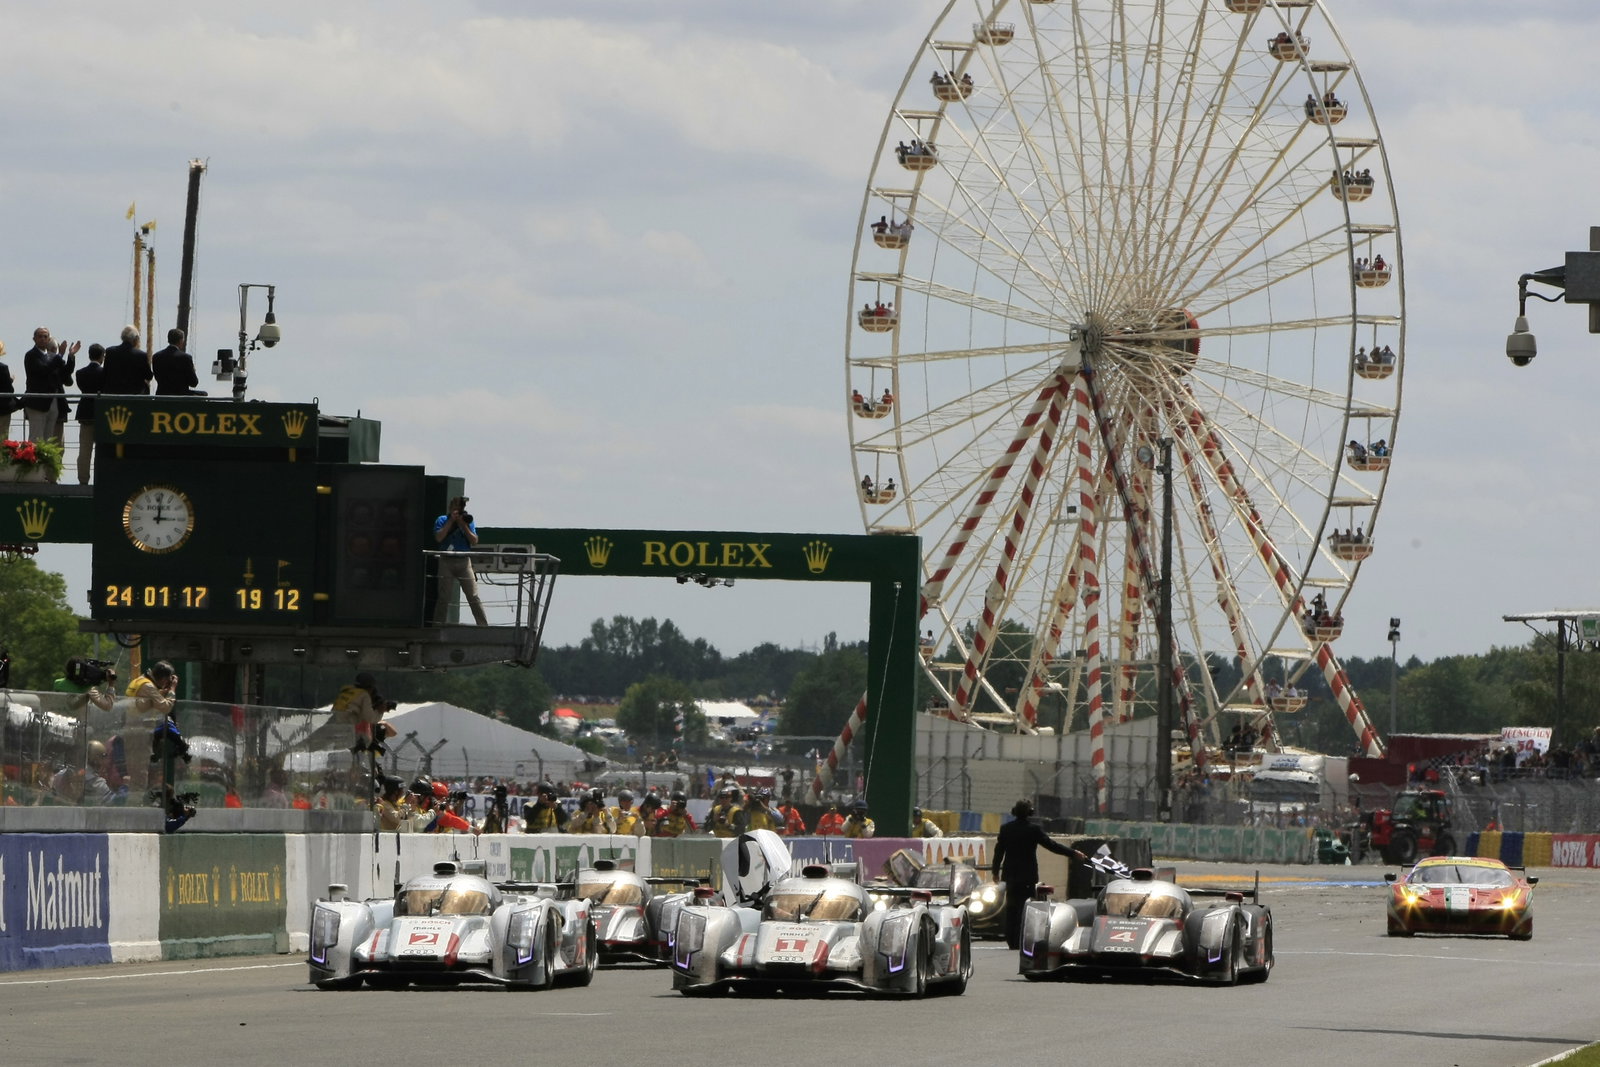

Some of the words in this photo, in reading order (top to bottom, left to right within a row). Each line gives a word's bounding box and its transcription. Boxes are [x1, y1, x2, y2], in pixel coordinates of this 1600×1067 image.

[150, 411, 262, 436] ROLEX
[642, 540, 773, 568] ROLEX
[236, 588, 262, 610] 19
[274, 589, 299, 610] 12
[1552, 840, 1588, 867] MOTUL
[26, 850, 103, 931] Matmut
[178, 873, 209, 905] ROLEX
[240, 871, 271, 903] ROLEX
[411, 933, 436, 945] 2
[780, 939, 800, 952] 1
[1109, 931, 1135, 943] 4
